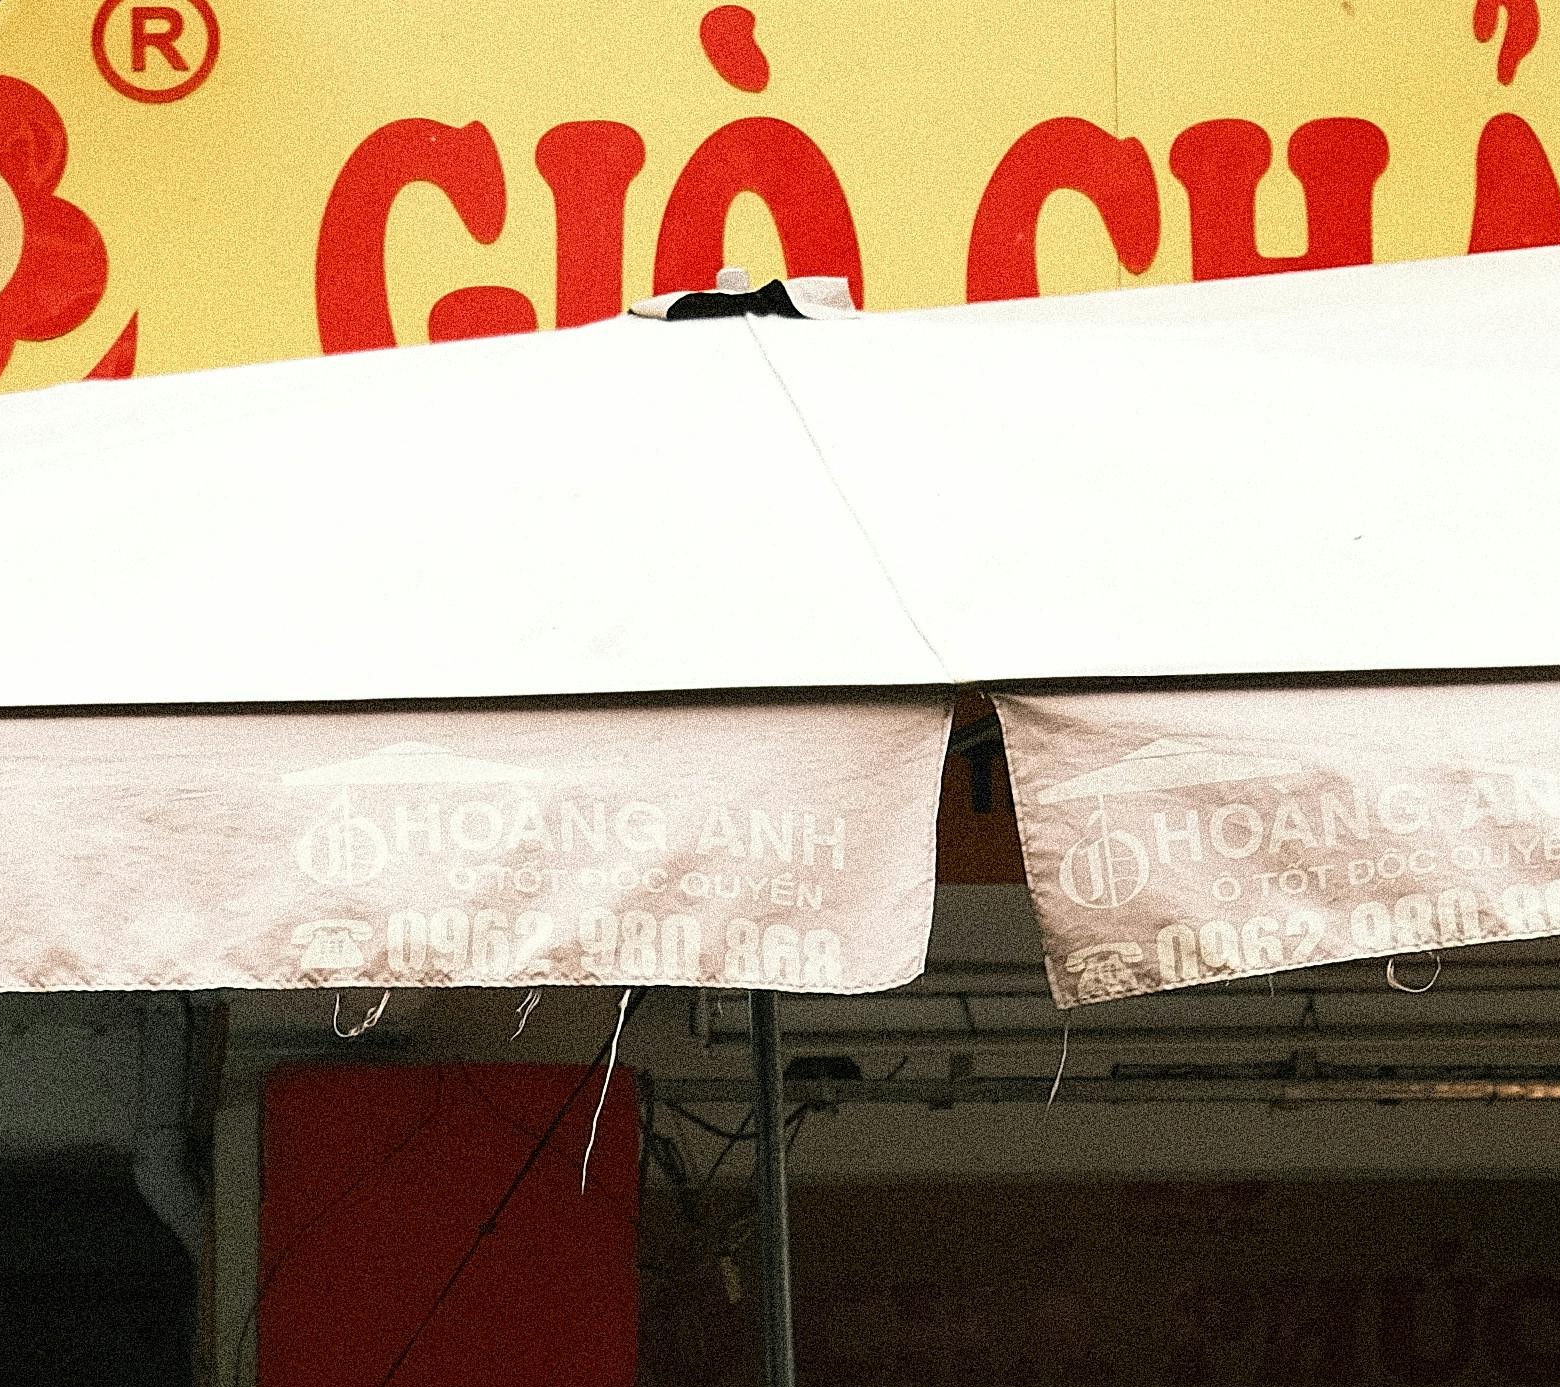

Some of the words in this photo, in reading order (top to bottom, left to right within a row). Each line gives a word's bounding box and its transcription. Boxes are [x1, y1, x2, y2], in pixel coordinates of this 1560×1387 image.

[395, 784, 668, 856] HOÀNG
[697, 801, 846, 870] ANH
[1152, 780, 1432, 866] HOÀNG
[387, 907, 555, 976] 0962
[579, 906, 702, 978] 980
[726, 918, 843, 982] 868
[1155, 911, 1327, 983] 0962
